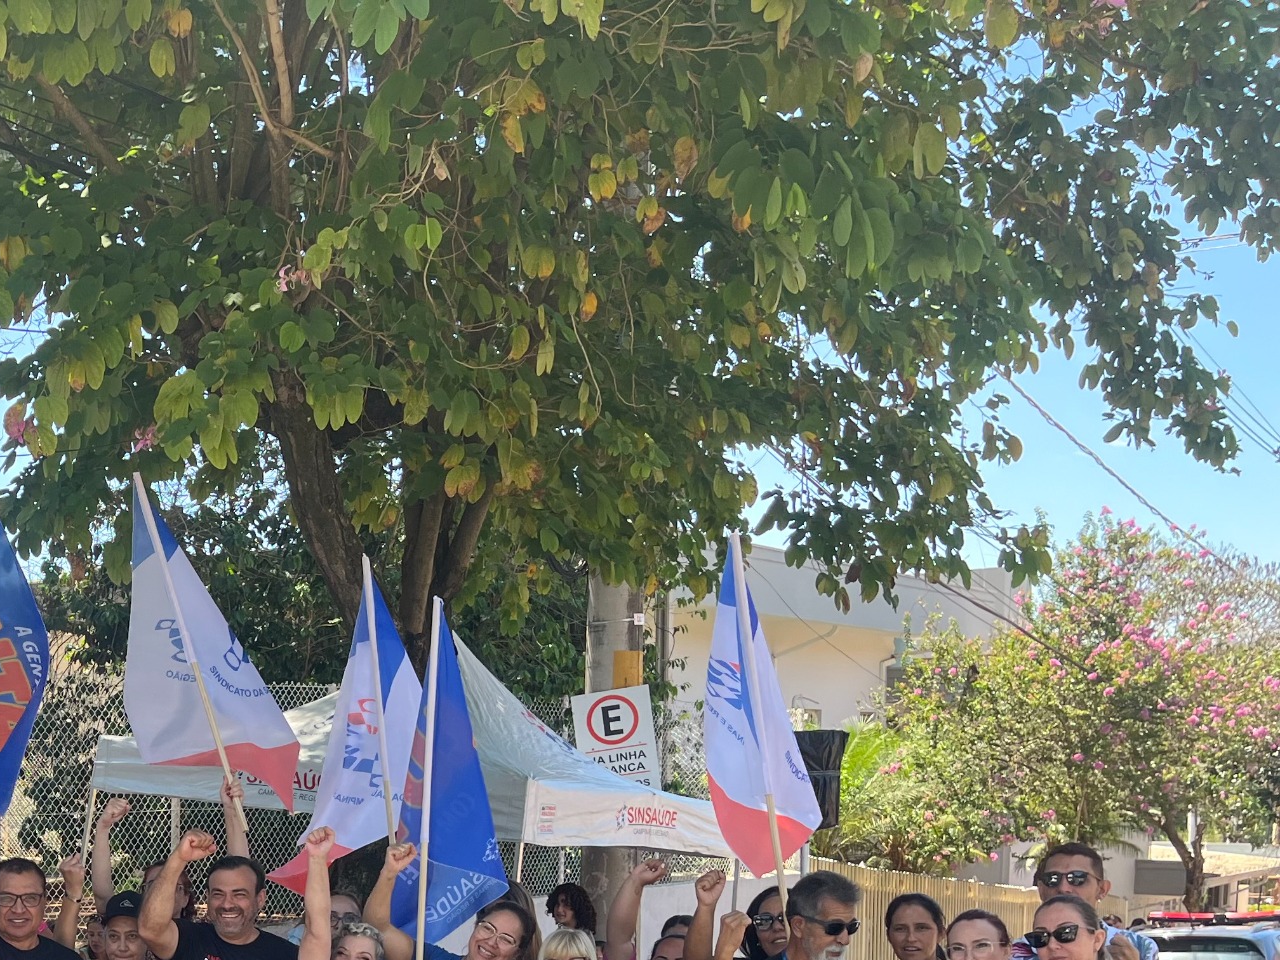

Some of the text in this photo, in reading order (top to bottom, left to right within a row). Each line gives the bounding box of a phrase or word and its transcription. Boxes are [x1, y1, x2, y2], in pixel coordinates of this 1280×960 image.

[14, 626, 33, 638] A
[209, 665, 252, 698] SINDICATO
[601, 704, 624, 737] E
[608, 749, 647, 763] LINHA
[605, 761, 646, 774] ANCA
[627, 805, 677, 828] SINSAÚDE
